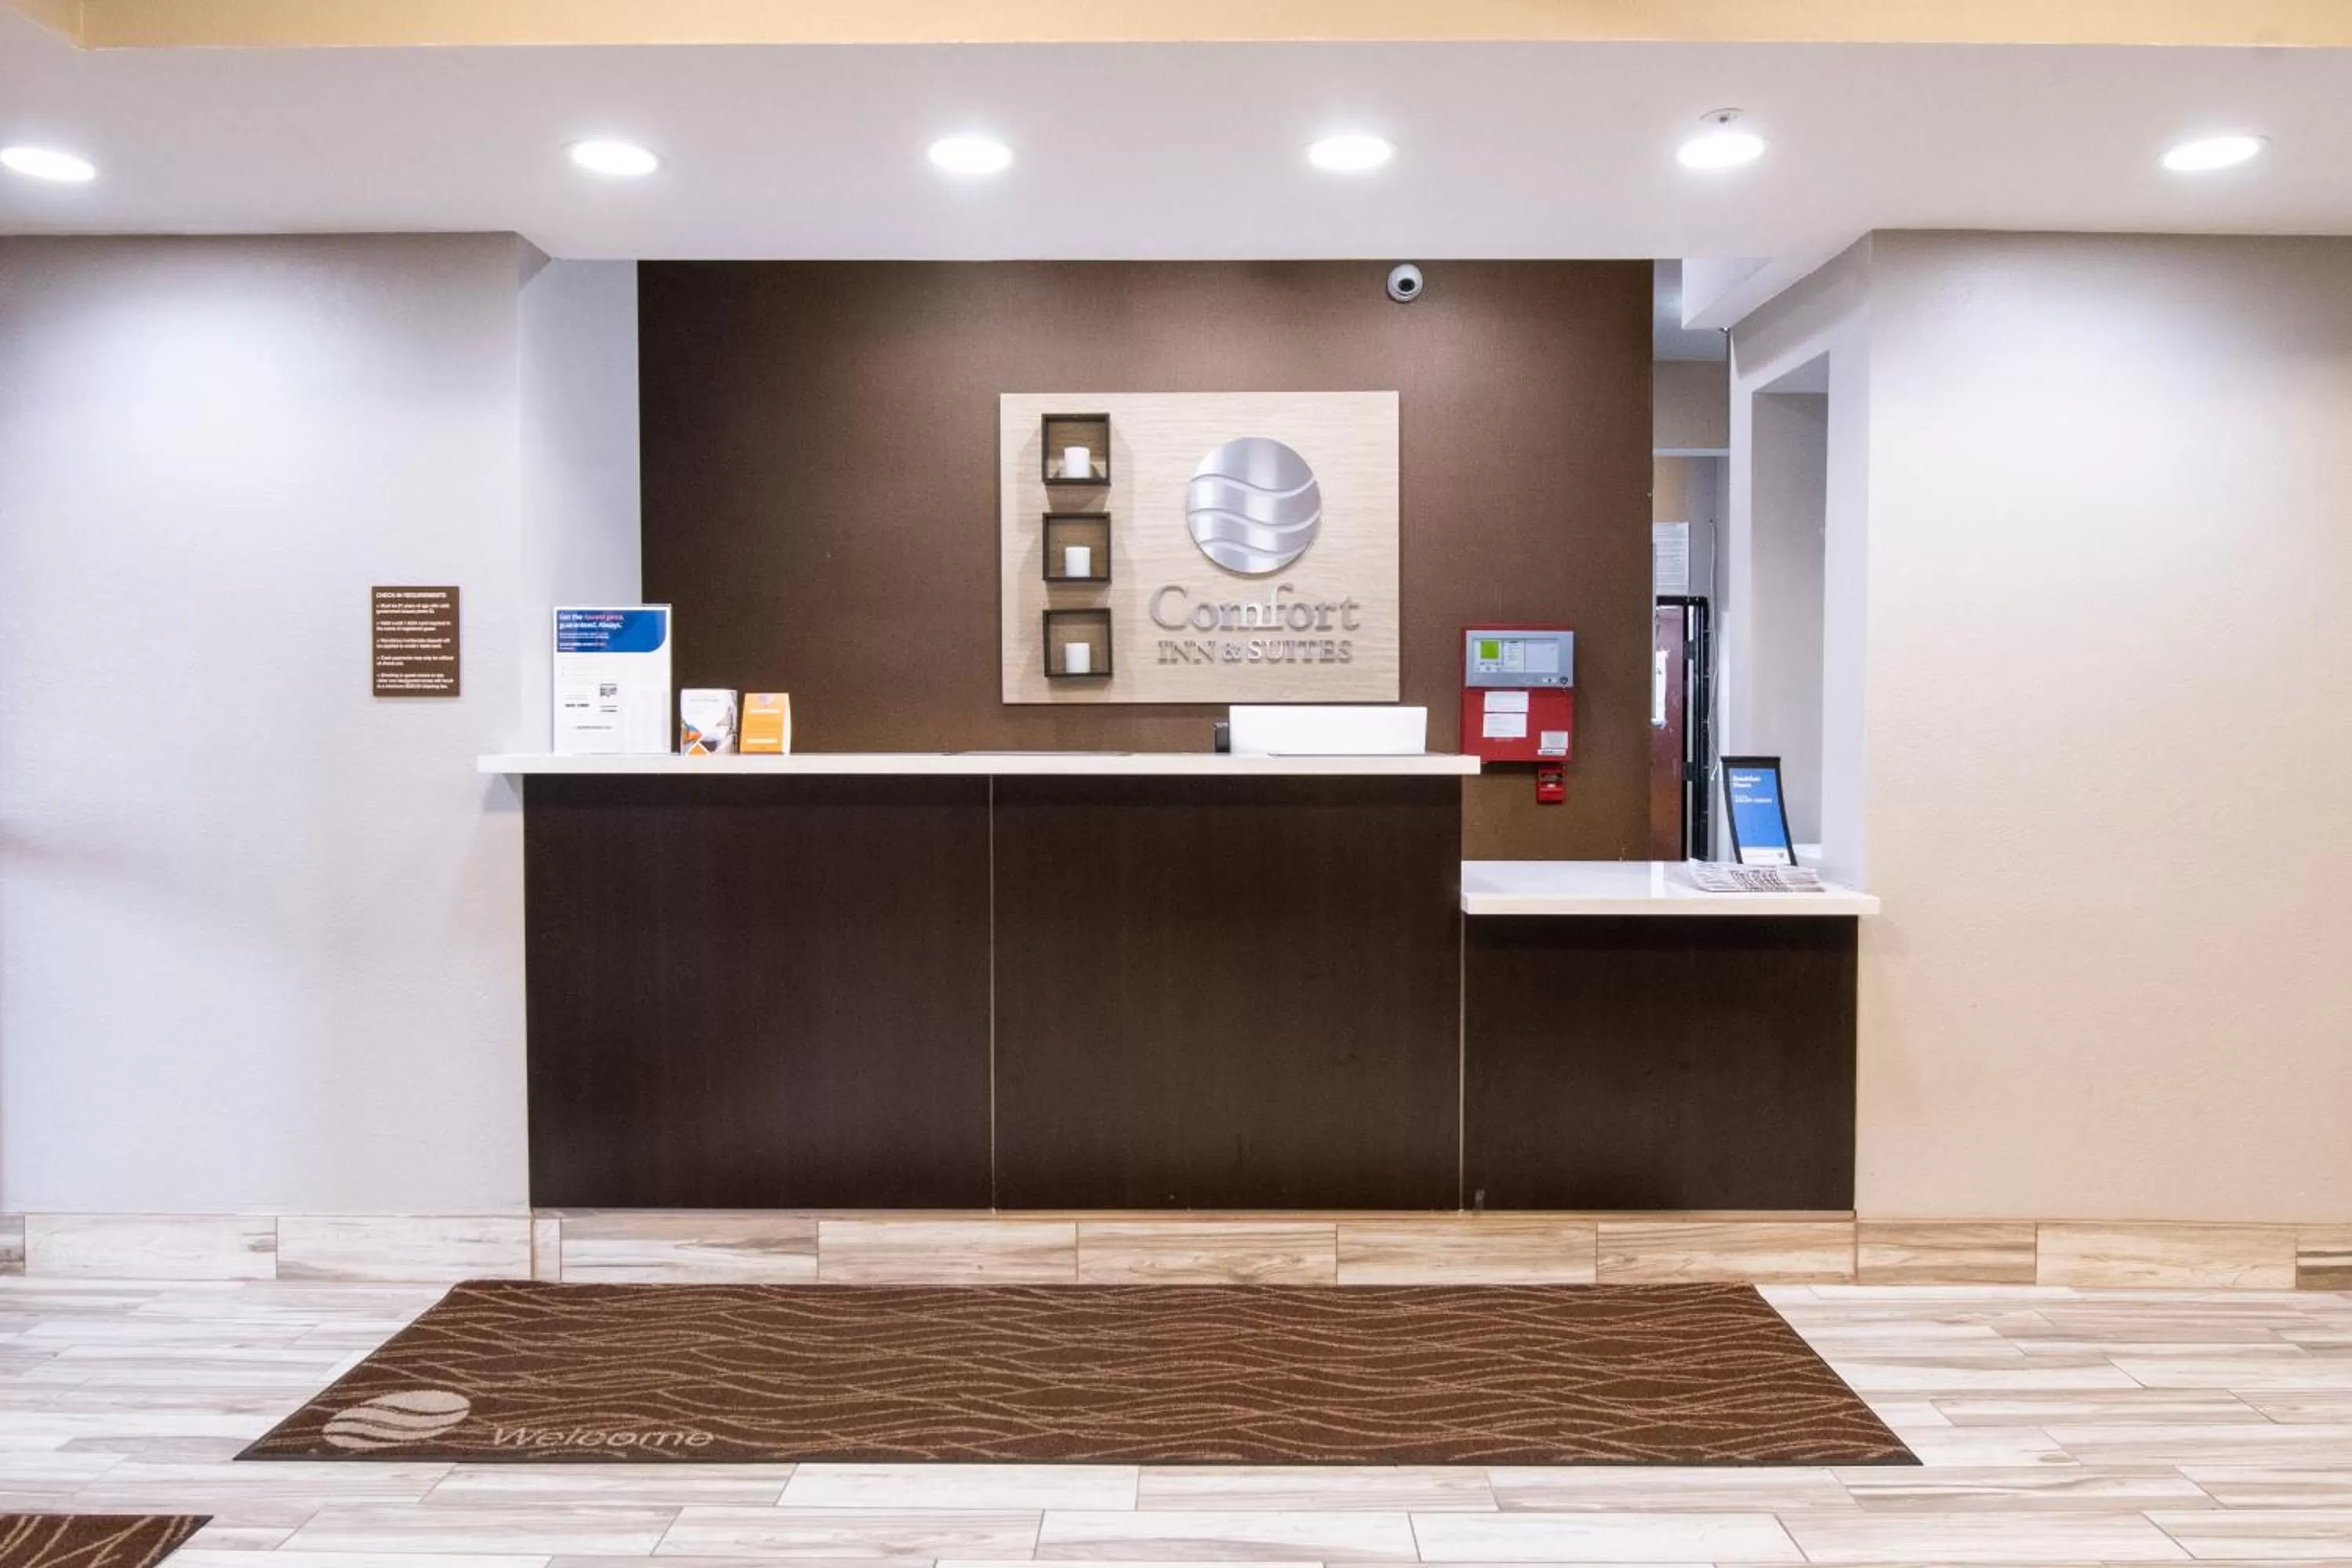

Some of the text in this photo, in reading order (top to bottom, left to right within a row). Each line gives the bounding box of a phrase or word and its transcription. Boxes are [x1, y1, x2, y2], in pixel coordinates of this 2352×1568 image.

[1149, 583, 1360, 632] Comfort
[1157, 639, 1353, 665] INN & SUITES
[492, 1427, 715, 1447] Welcome
